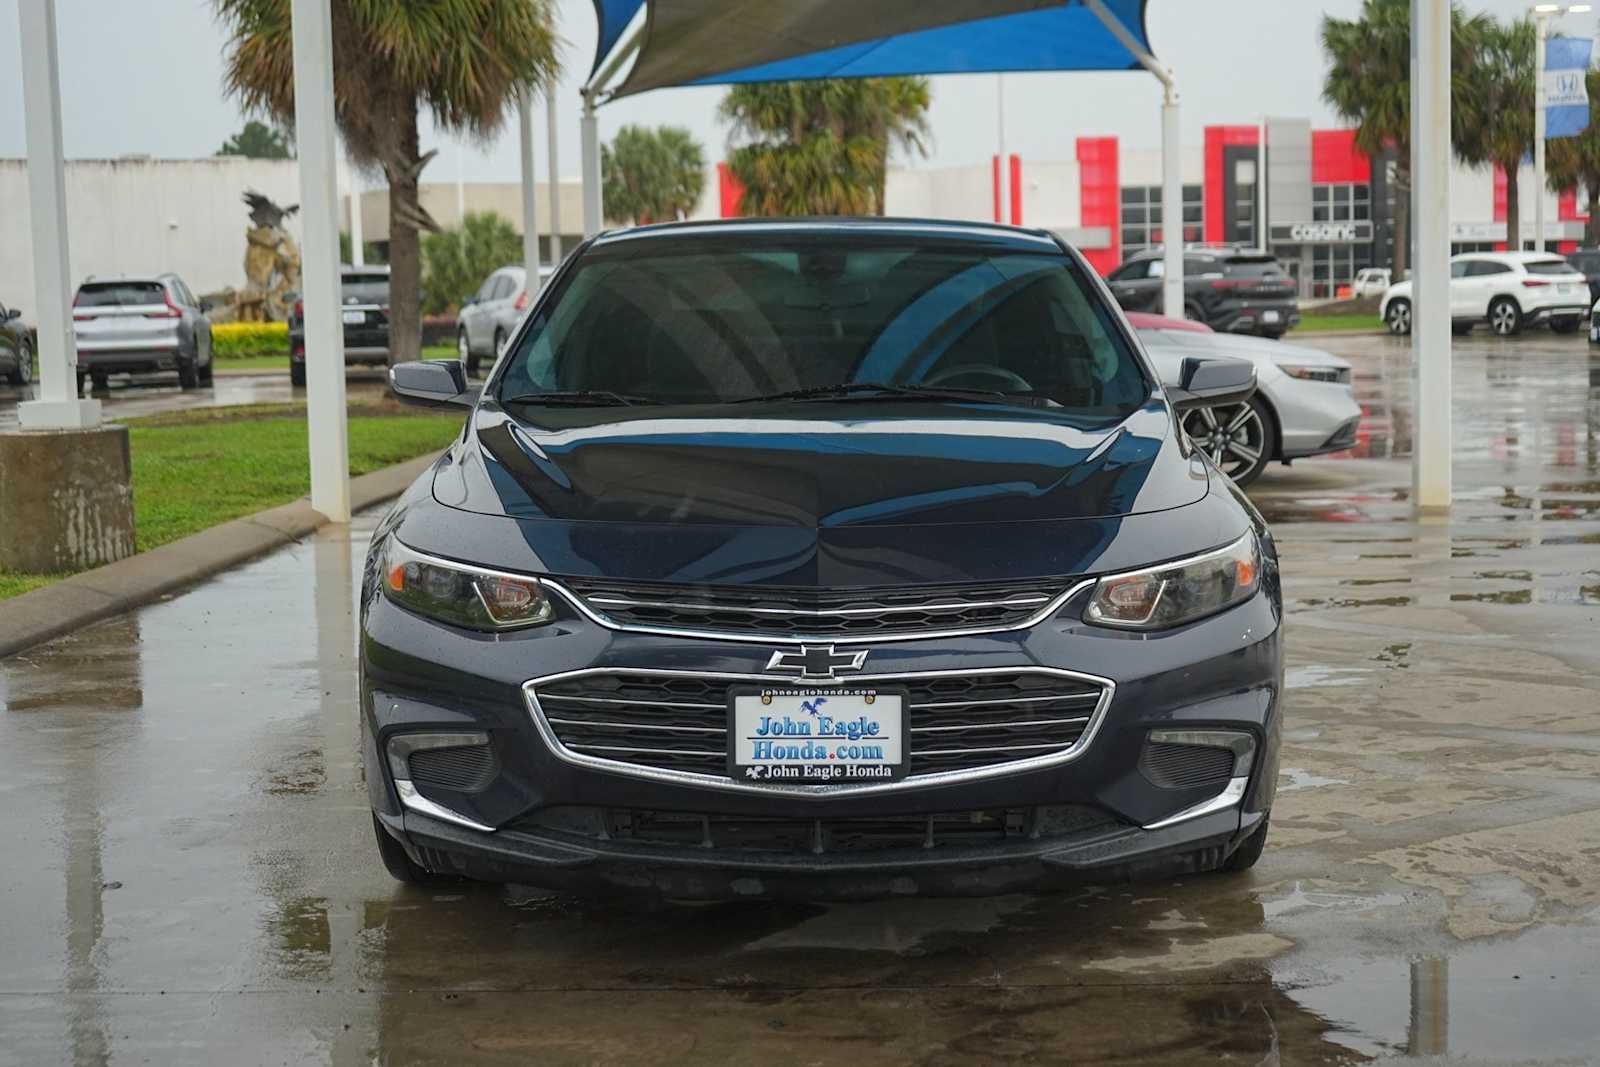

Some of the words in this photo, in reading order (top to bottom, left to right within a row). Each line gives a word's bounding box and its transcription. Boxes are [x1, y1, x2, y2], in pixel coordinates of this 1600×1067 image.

[756, 716, 812, 736] John
[817, 716, 880, 741] Eagle
[751, 740, 884, 760] Honda.com
[764, 765, 799, 778] John
[803, 764, 842, 781] Eagle
[845, 764, 892, 777] Honda
